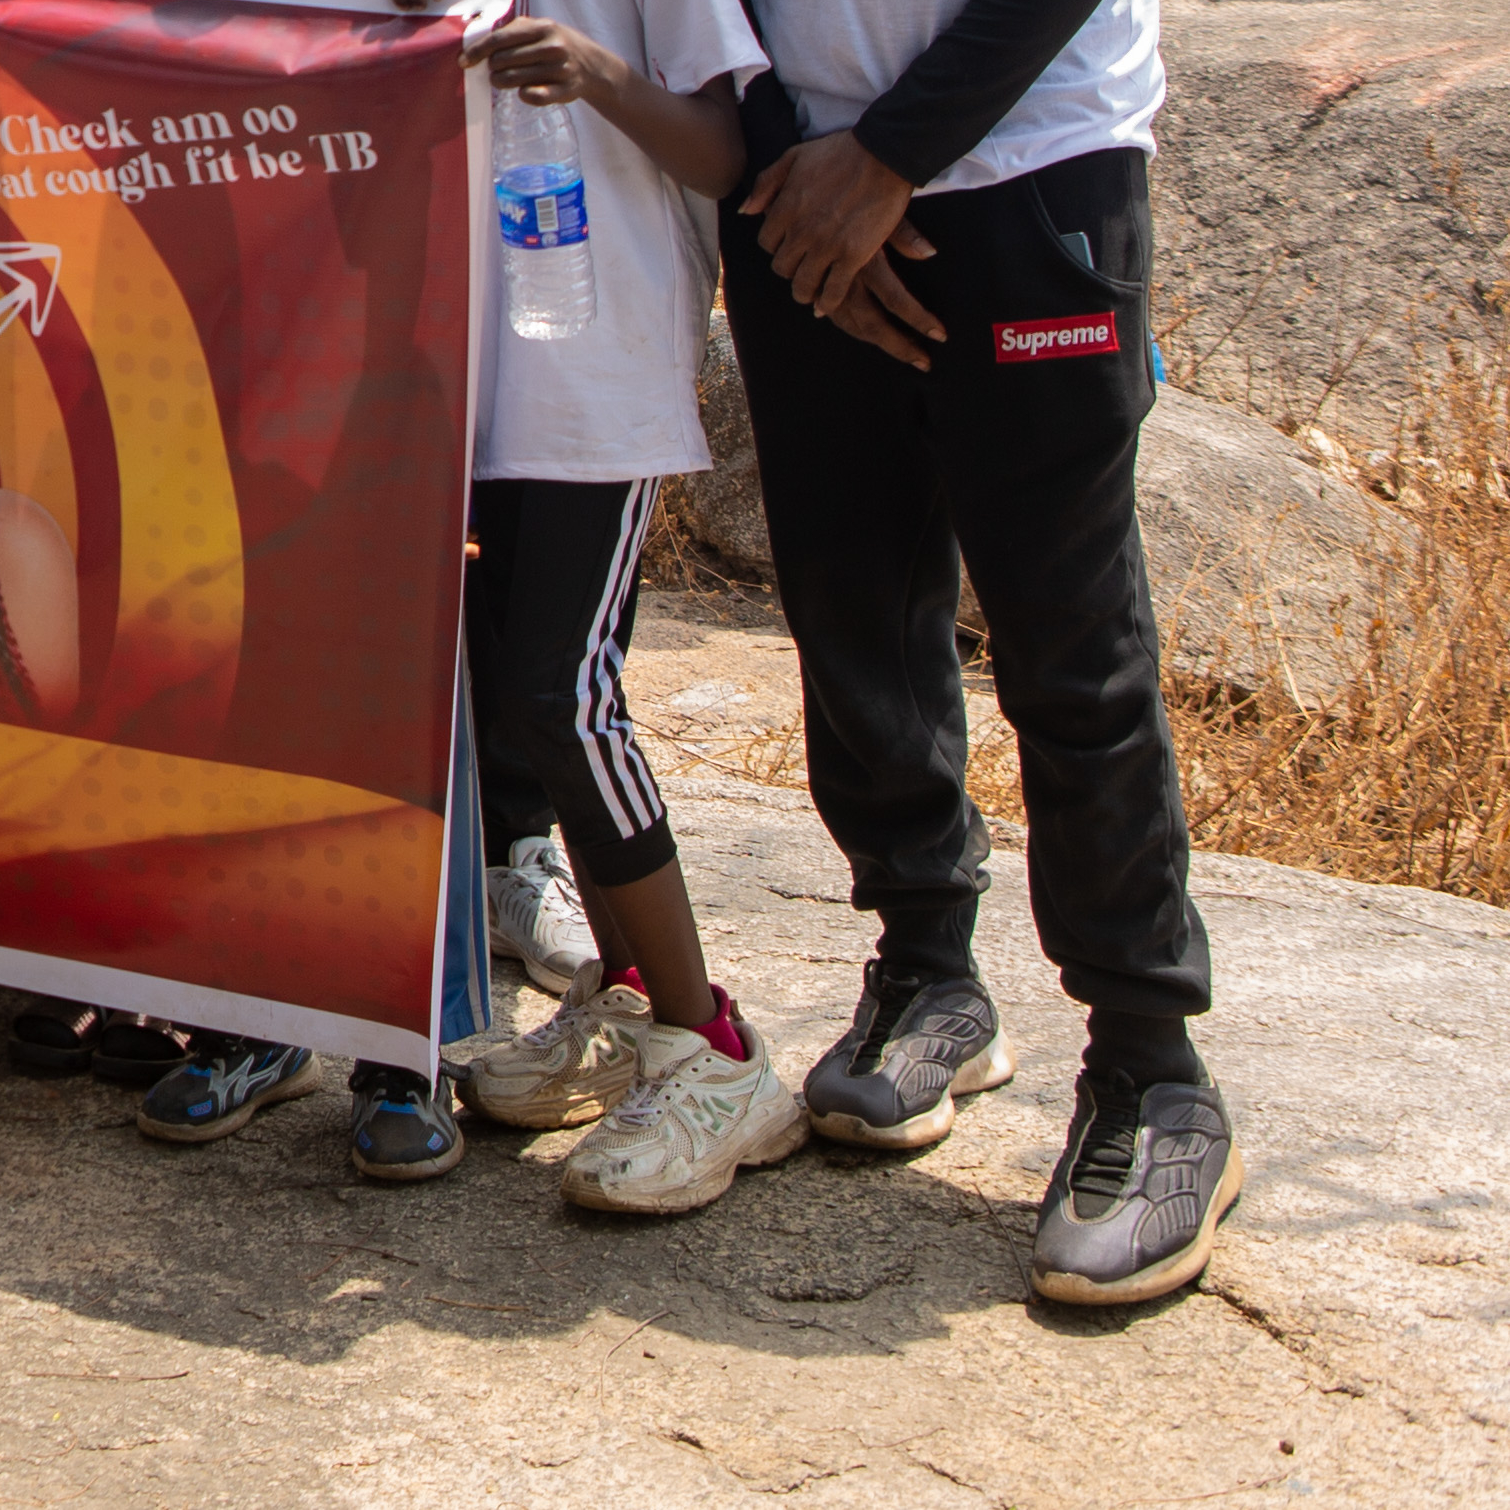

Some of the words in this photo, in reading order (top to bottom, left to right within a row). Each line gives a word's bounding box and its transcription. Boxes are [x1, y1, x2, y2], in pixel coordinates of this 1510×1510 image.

[152, 110, 234, 144] am
[243, 104, 298, 135] oo
[45, 151, 176, 204] cough
[183, 145, 239, 186] fit
[245, 142, 305, 180] be
[309, 131, 378, 174] TB
[1001, 325, 1108, 355] Supreme
